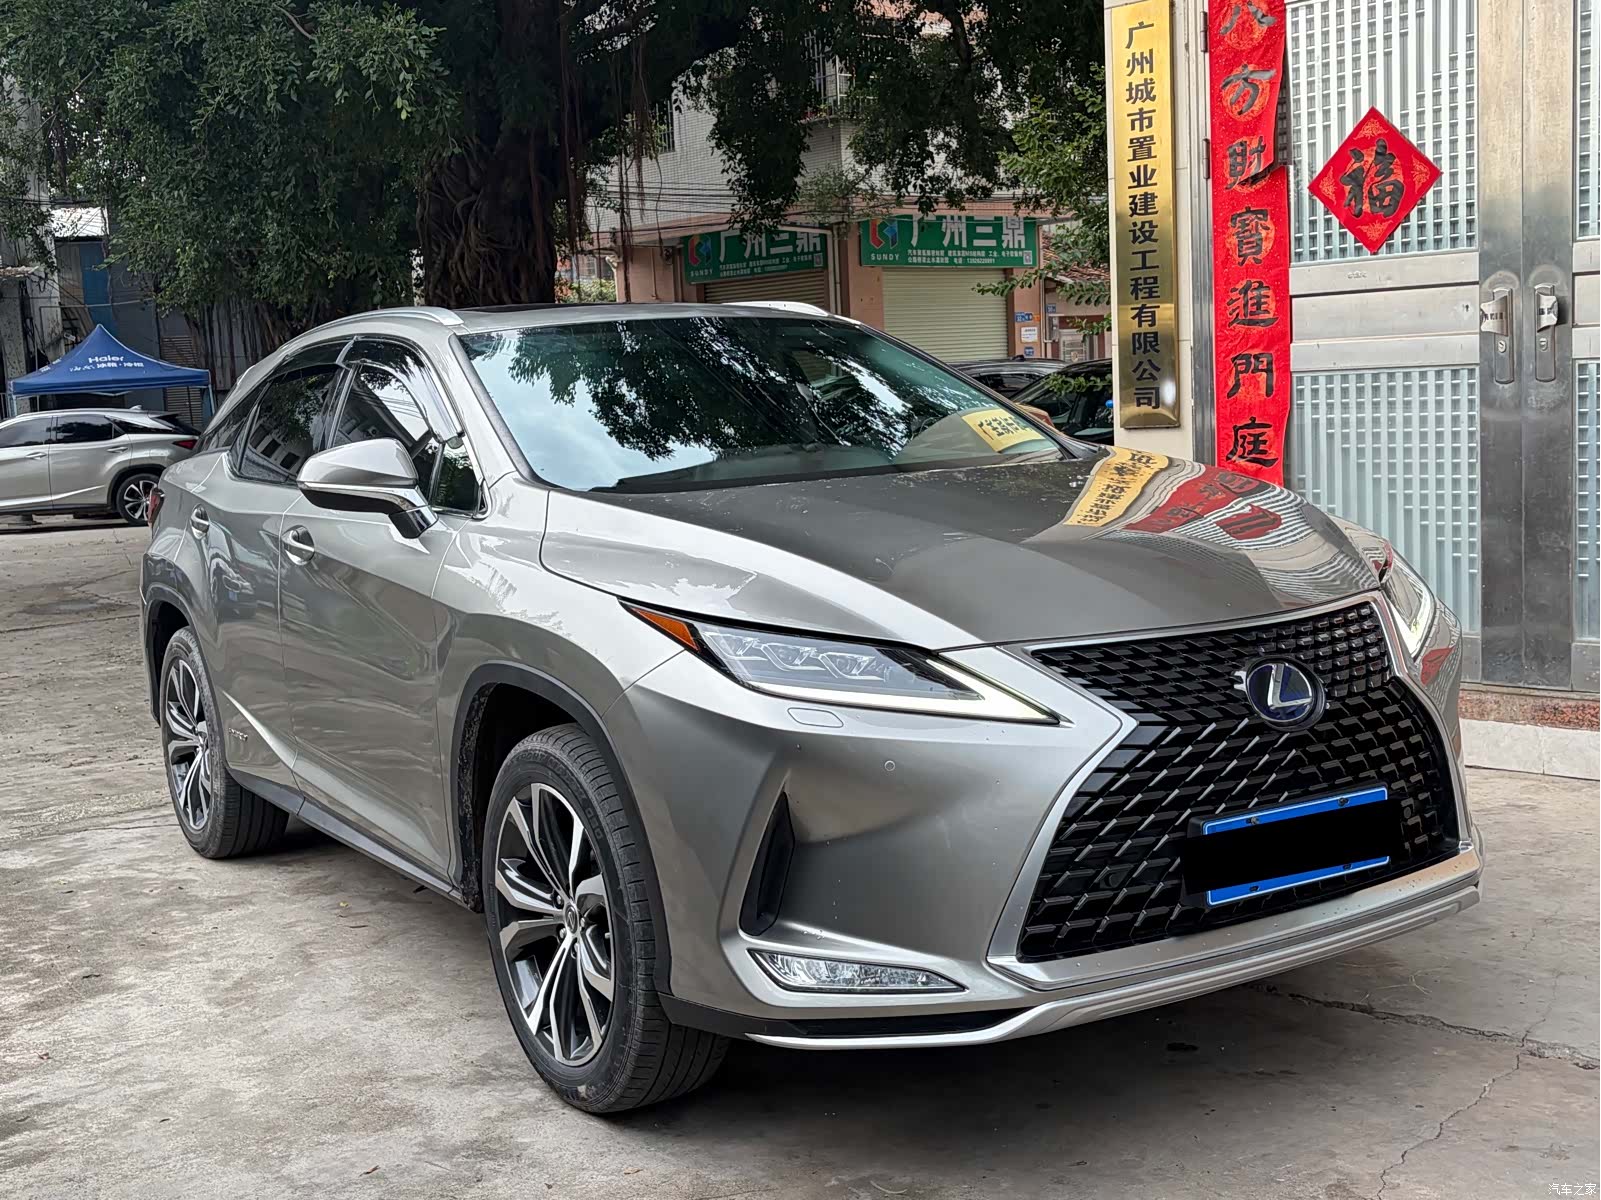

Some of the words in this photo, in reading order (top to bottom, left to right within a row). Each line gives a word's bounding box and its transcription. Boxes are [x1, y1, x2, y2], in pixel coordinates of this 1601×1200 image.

[1340, 138, 1405, 219] 福
[911, 212, 1025, 249] 广州三鼎
[1125, 21, 1161, 410] 广州城市置业建设工程有限公司
[870, 253, 900, 261] SUNDY
[88, 355, 124, 363] Haier
